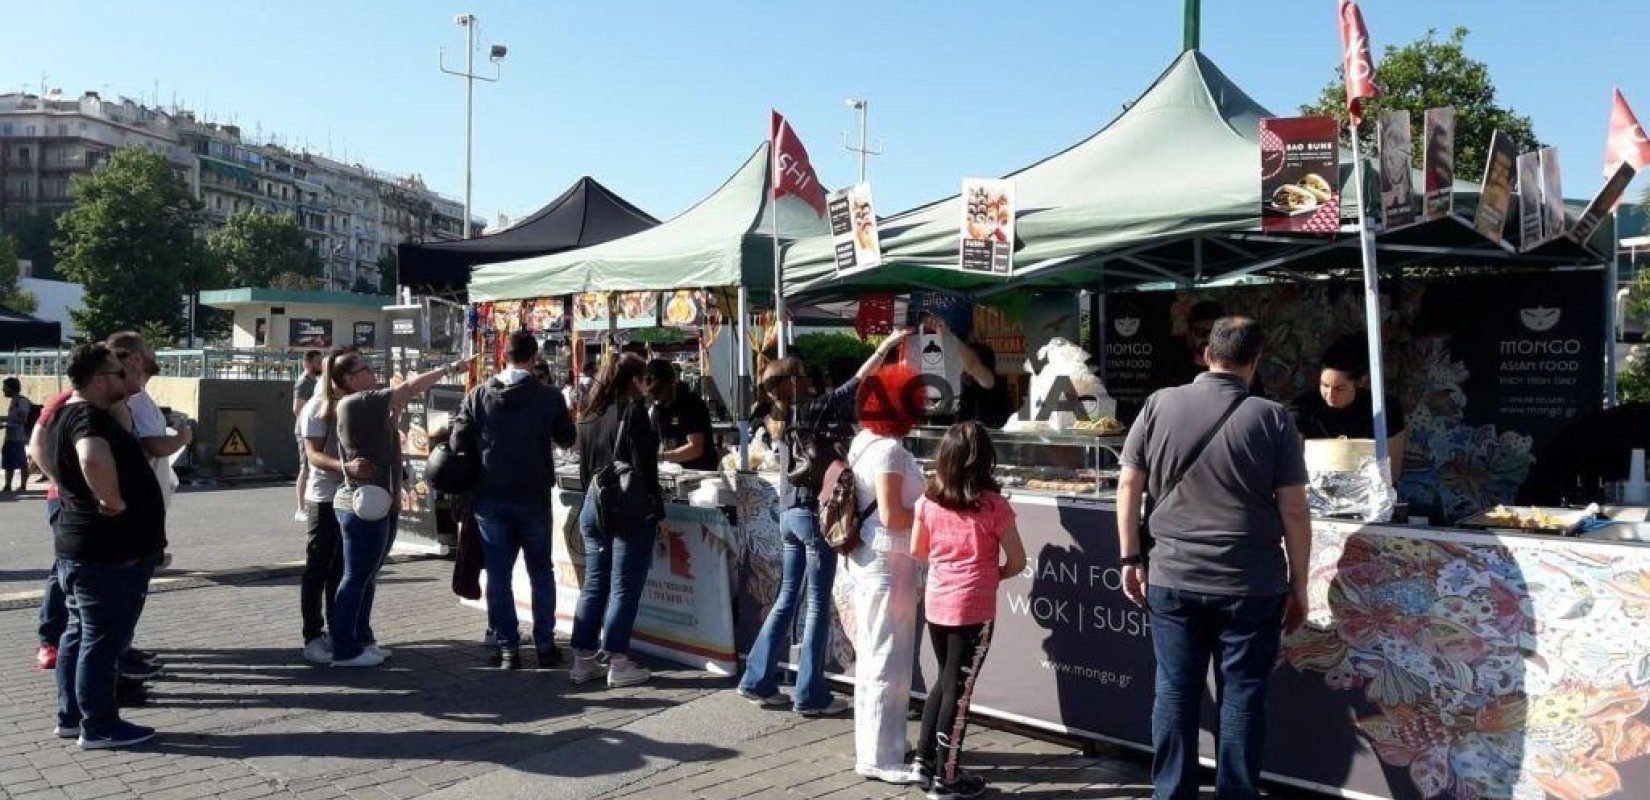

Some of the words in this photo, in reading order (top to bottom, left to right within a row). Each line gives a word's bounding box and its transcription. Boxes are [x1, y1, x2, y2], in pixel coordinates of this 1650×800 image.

[1307, 142, 1332, 150] BUNS
[780, 153, 811, 190] SHI
[1499, 339, 1581, 354] MONGO
[1499, 360, 1535, 371] ASIAN
[1538, 360, 1580, 372] FOOD
[1019, 557, 1077, 585] SIAN
[1089, 565, 1123, 591] FO
[1007, 592, 1070, 624] WOK
[1093, 605, 1151, 637] SUSH
[1040, 659, 1134, 688] www.mongo.gr
